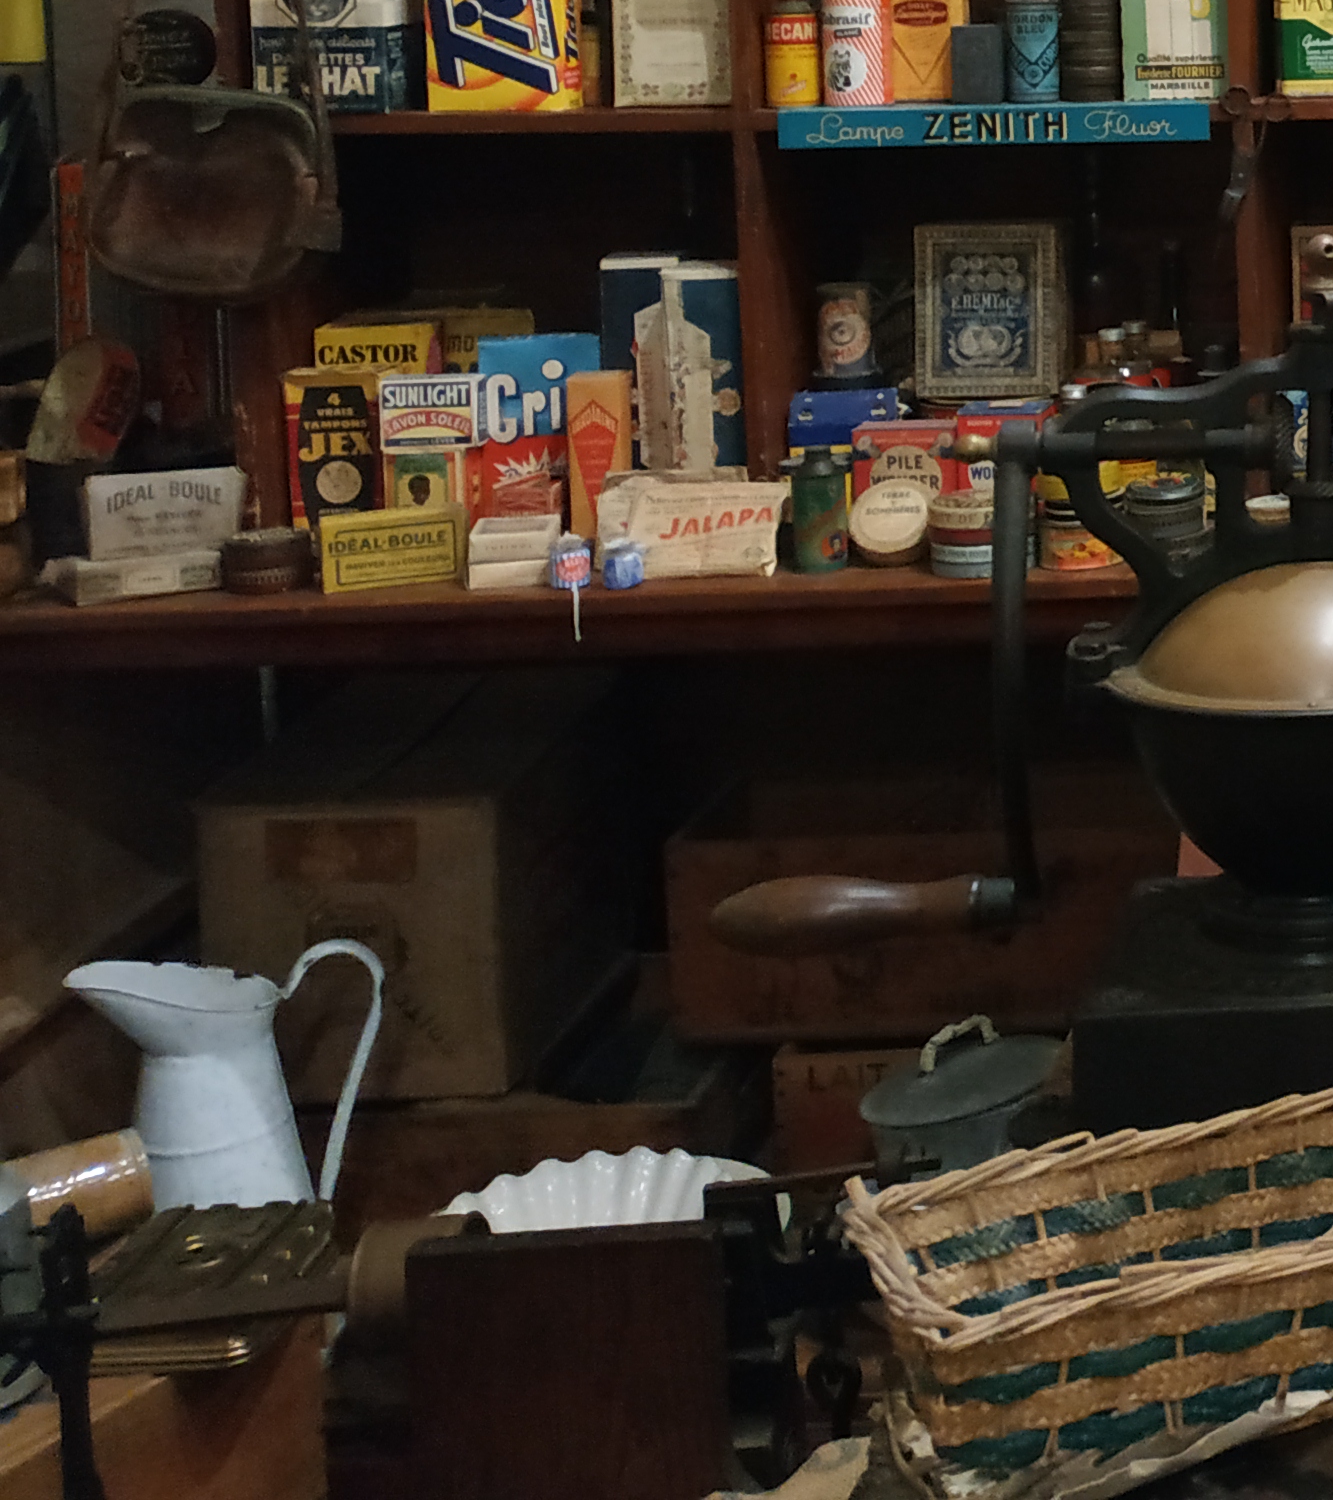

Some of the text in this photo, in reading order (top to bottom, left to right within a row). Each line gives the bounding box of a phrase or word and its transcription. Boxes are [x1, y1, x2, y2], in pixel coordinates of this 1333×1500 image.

[1149, 81, 1211, 90] MARSEILLE
[805, 110, 1177, 146] Lampe ZENITH Fluor
[318, 344, 418, 365] CASTOR
[327, 393, 341, 405] 4
[383, 384, 470, 408] SUNLIGHT
[485, 359, 564, 443] Cri
[386, 413, 425, 435] SAVON
[299, 432, 373, 461] JEX
[886, 454, 923, 470] PILE
[659, 506, 774, 541] JALAPA
